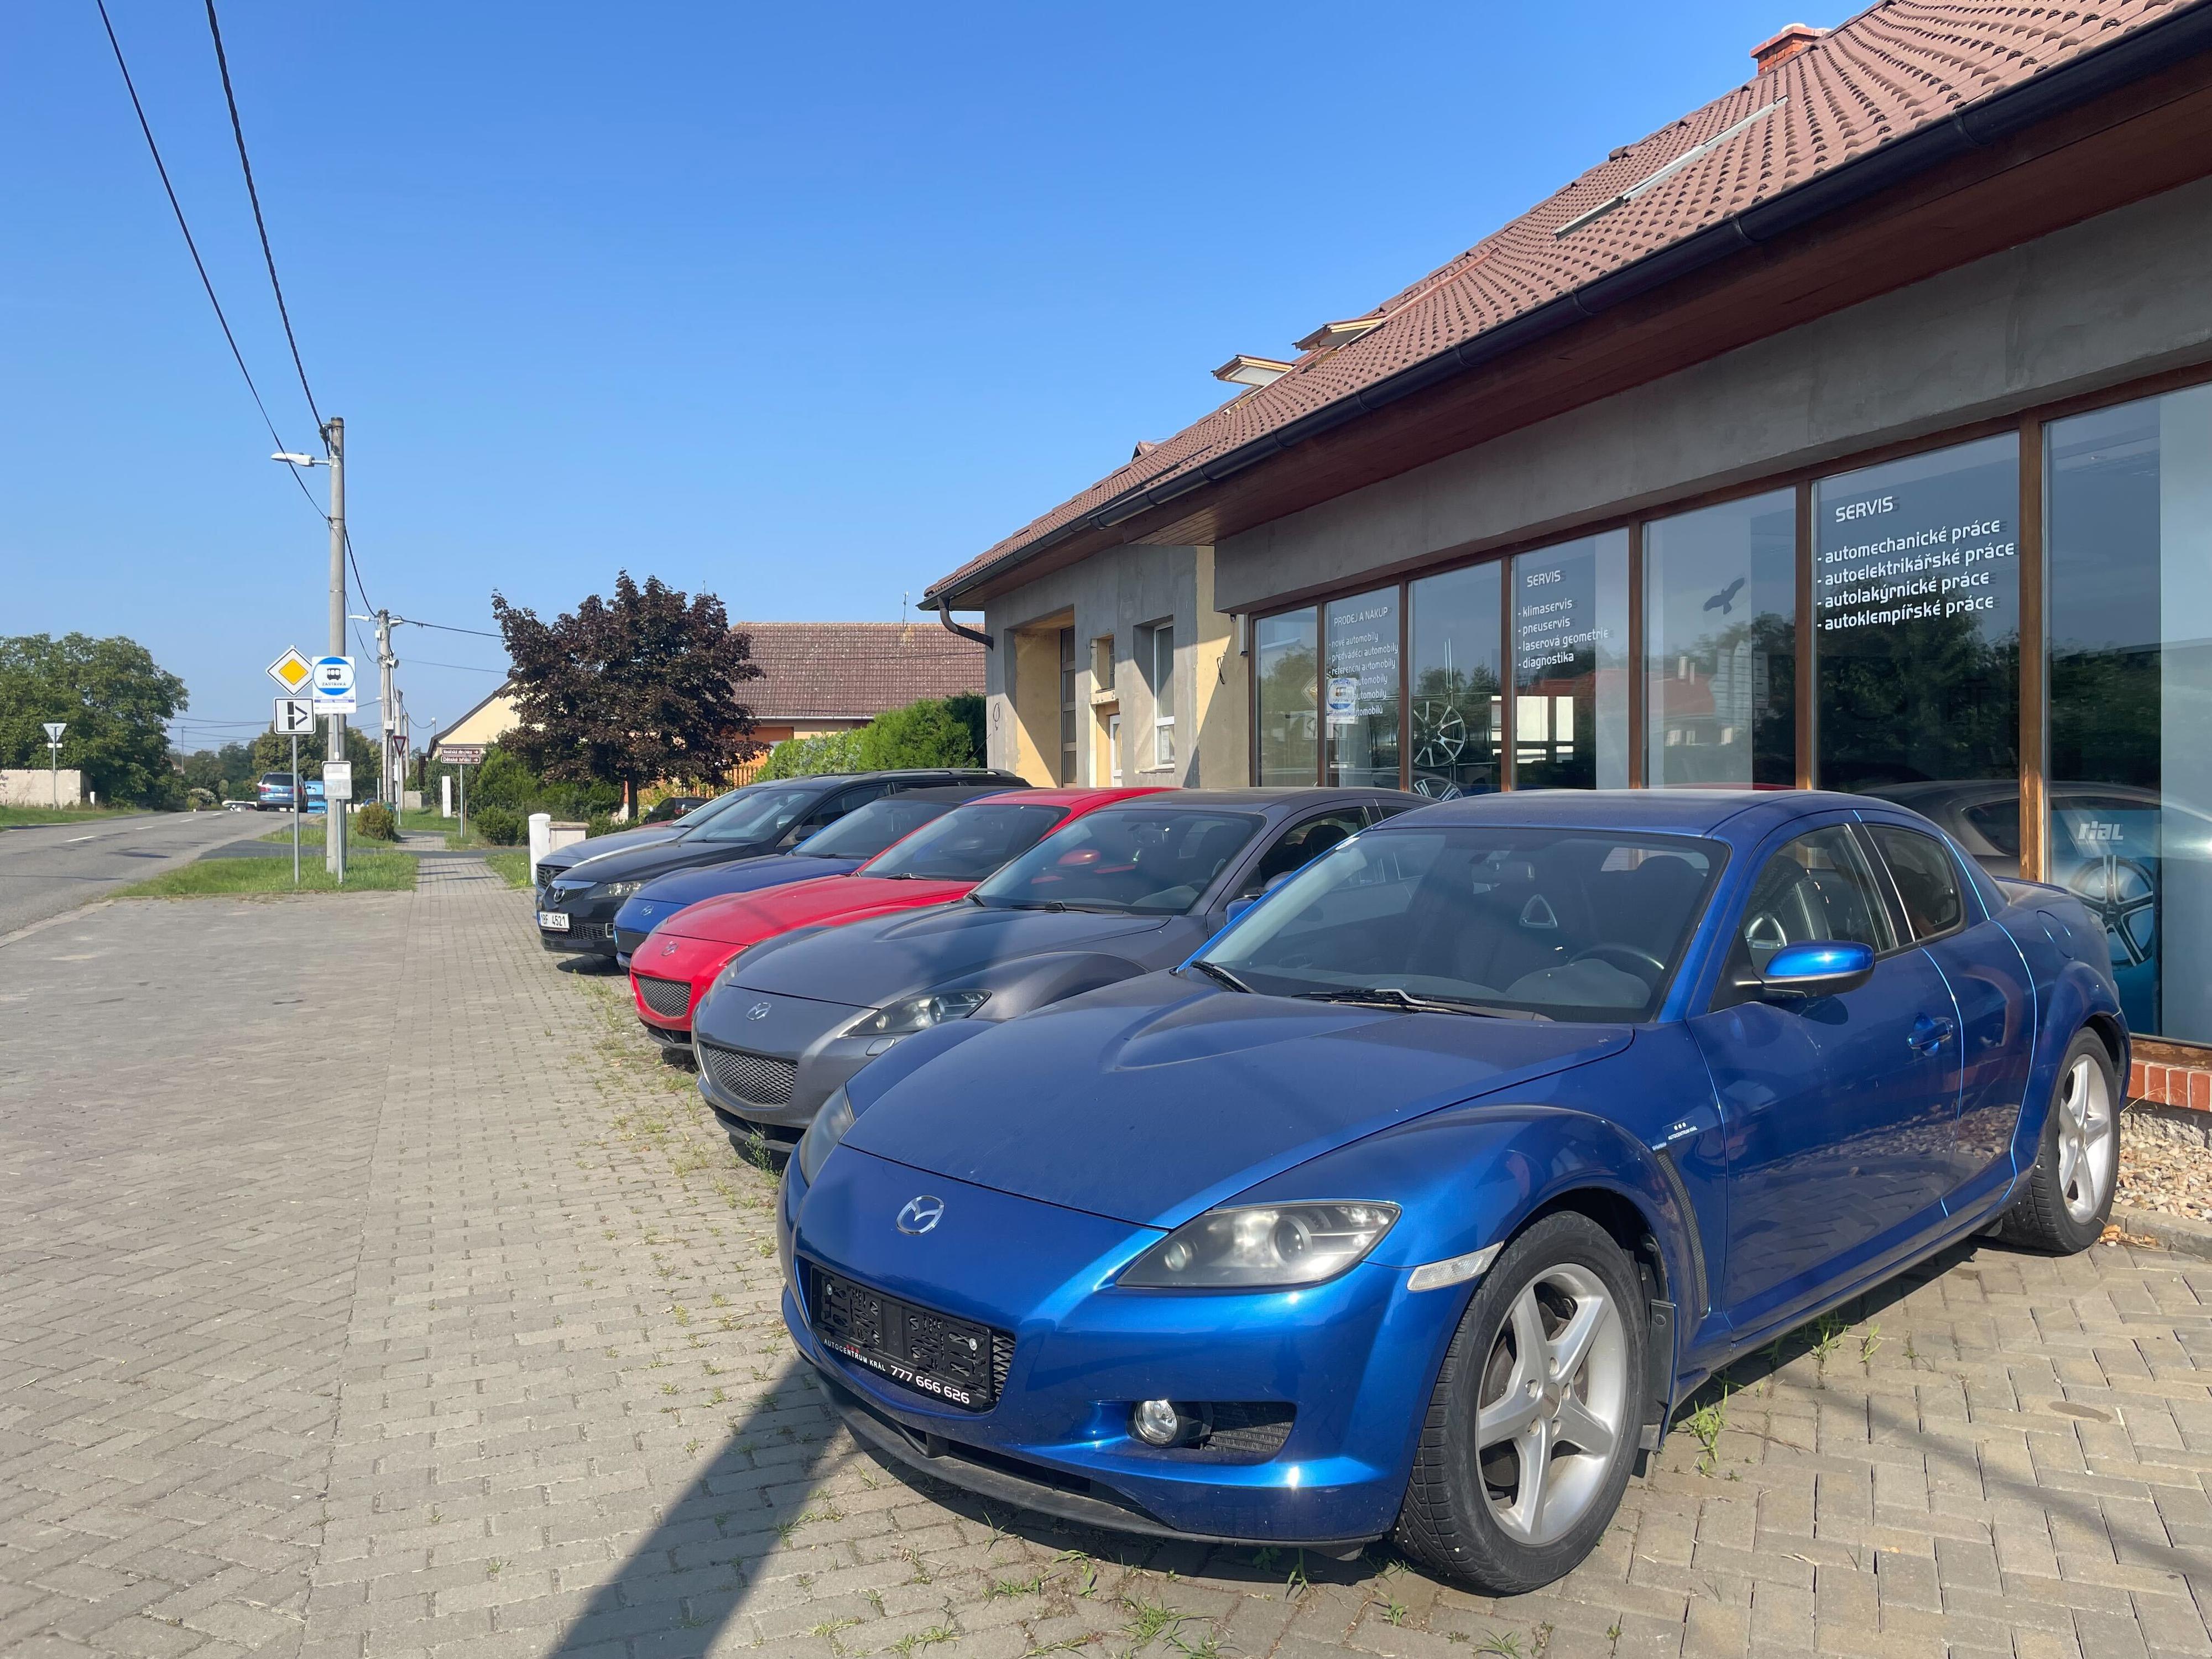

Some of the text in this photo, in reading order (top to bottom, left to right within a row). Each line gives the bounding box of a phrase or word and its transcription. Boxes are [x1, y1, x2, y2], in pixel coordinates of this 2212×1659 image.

[1835, 496, 1893, 523] SERVIS
[1825, 520, 2000, 564] automechanické práce
[1825, 542, 2014, 585] autoelektrikářské práce
[1527, 570, 1561, 587] SERVIS
[1825, 571, 1989, 608] autolakýrnické práce
[1523, 598, 1572, 618] klimaservis
[1825, 595, 1994, 630] autoklempířské práce
[1334, 613, 1358, 627] PRODEJ
[1359, 612, 1364, 622] A
[1523, 616, 1571, 637] pneuservis
[1346, 632, 1379, 645] automobily
[1523, 627, 1609, 652] laserová geometrie
[1364, 642, 1399, 656] automobily
[1361, 658, 1396, 671] automobily
[1523, 651, 1574, 669] diagnostika
[552, 915, 566, 927] 4521
[824, 1338, 970, 1404] AUTOCENTRUM KRÁL 777 666 626
